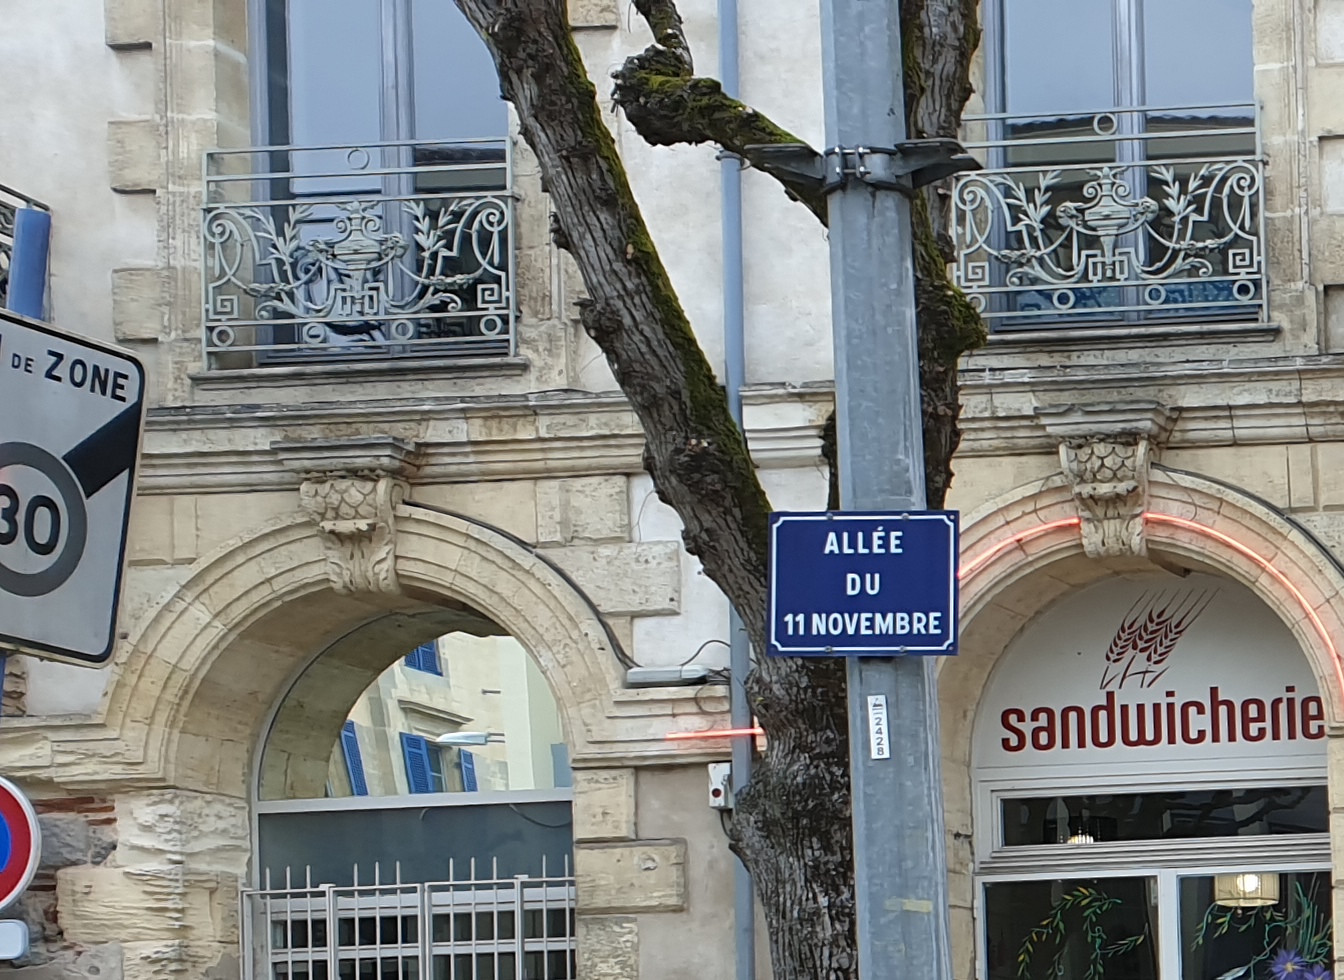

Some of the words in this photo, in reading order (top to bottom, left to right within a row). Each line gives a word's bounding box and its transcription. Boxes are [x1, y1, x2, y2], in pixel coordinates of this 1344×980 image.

[11, 352, 35, 374] DE
[44, 350, 129, 403] ZONE
[0, 483, 61, 556] 30
[824, 526, 903, 555] ALLÉE
[846, 572, 881, 596] DU
[783, 613, 805, 636] 11
[811, 611, 942, 636] NOVEMBRE
[874, 716, 885, 756] 2428
[1000, 685, 1326, 752] sandwicherie
